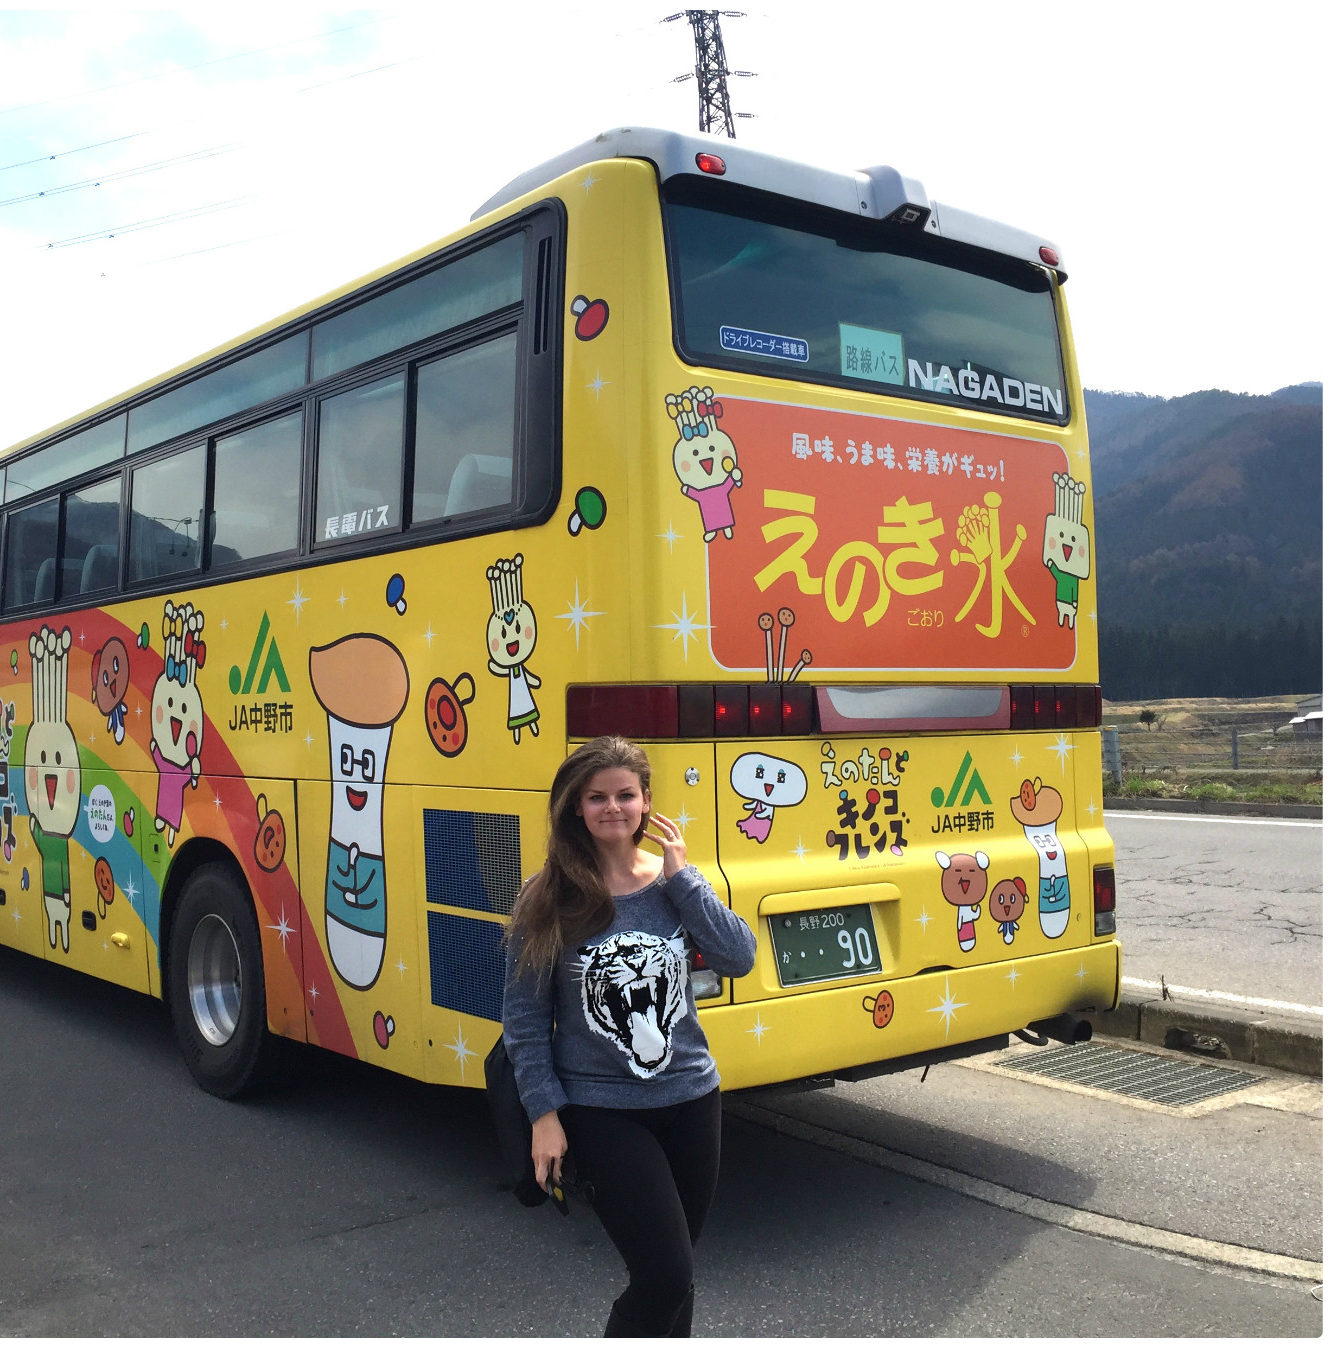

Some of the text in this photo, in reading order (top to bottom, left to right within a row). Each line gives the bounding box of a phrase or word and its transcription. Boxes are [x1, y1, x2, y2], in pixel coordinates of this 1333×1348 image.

[846, 345, 900, 376] 路線バス
[908, 359, 1063, 415] NAGADEN
[325, 505, 389, 539] 長電バス
[753, 489, 1036, 638] えのき氷
[907, 608, 944, 627] ごおり
[229, 701, 293, 733] JA中野市
[931, 810, 995, 834] JA中野市
[837, 927, 873, 968] 90
